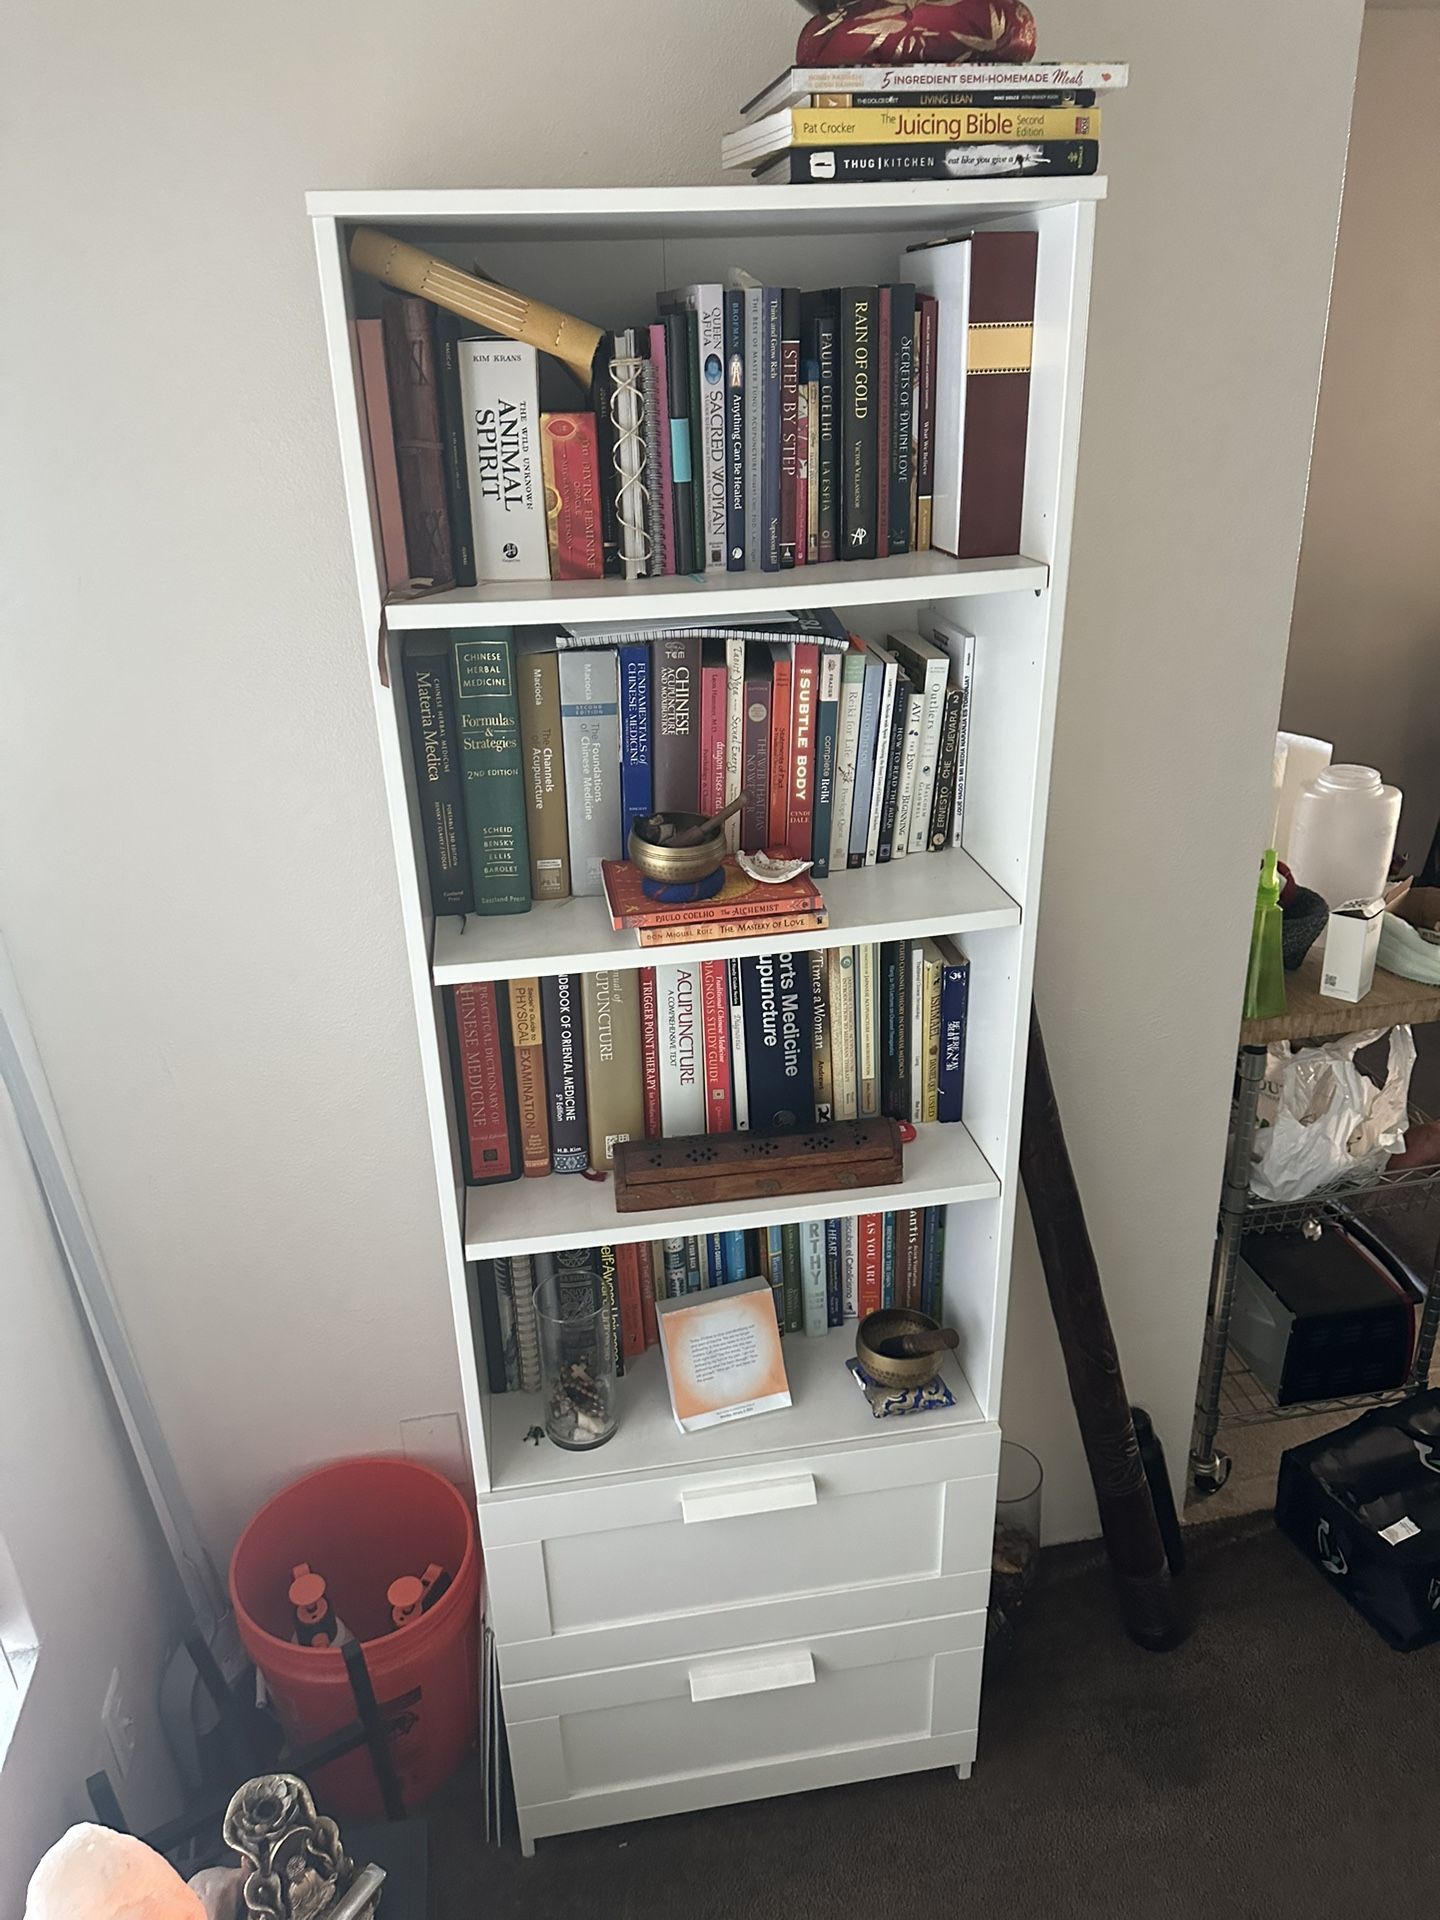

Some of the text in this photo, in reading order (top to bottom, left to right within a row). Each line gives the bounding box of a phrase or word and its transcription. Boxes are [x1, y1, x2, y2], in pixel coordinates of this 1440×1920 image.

[881, 71, 894, 89] 5
[893, 75, 957, 86] INGREDIENT
[960, 74, 1049, 85] SEMI-HOMEMADE
[1052, 69, 1084, 86] Meals
[920, 95, 973, 105] LIVING LEAN
[803, 122, 855, 134] Pat Crocker
[881, 113, 1013, 140] The Juicing Bible
[1016, 115, 1044, 126] Second
[1016, 127, 1044, 137] Edition
[844, 157, 935, 168] THUG KITCHEN
[977, 157, 991, 167] you
[712, 307, 722, 350] QUEEN
[770, 299, 779, 379] Think Rich
[472, 353, 522, 363] KIM KRANS
[782, 350, 798, 394] STEP
[855, 302, 868, 419] RAIN OF GOLD
[821, 332, 833, 441] PAULO COELHO
[783, 402, 798, 425] BY
[898, 336, 913, 484] SECRETS OF DIVINE LOVE
[474, 410, 501, 501] SPIRIT
[498, 399, 523, 512] ANIMAL
[519, 401, 533, 511] THE WILD UNKNOWN
[709, 391, 726, 536] SACRED WOMAN
[731, 394, 742, 510] Anything Can Be Healed
[782, 433, 797, 476] STEP
[822, 460, 831, 475] LA
[584, 510, 597, 570] FEMININE
[464, 653, 502, 663] CHINESE
[467, 666, 501, 675] HERBAL
[463, 678, 508, 688] MEDICINE
[533, 668, 544, 706] Maciocia
[583, 663, 593, 701] Maciocia
[660, 666, 669, 736] AND MOXIBUSTION
[667, 667, 676, 736] ACUPUNCTURE
[675, 667, 690, 736] CHINESE
[728, 646, 743, 743] Taoist Yoga Sexual
[416, 672, 442, 781] Materia Medica
[462, 713, 516, 728] Formulas
[627, 663, 639, 766] CHINESE MEDICINE
[637, 663, 649, 765] FUNDAMENTALS of
[843, 691, 859, 758] Reiki for Life
[911, 703, 921, 722] AVI
[926, 683, 941, 729] Outliers
[464, 736, 518, 753] Strategies
[485, 728, 495, 738] &
[795, 678, 811, 800] SUBTLE BODY
[440, 740, 451, 773] MEDICINE
[467, 769, 519, 780] 2ND EDITION
[532, 748, 544, 809] Acupuncture
[544, 748, 556, 793] Channels
[580, 736, 594, 821] Chinese Medicine
[591, 723, 603, 803] The Foundations
[712, 741, 726, 810] dragon rises red
[746, 754, 756, 770] NO
[756, 736, 767, 809] THE THAT
[820, 735, 833, 804] complete Reiki
[890, 727, 904, 806] HOW TO READ THE
[937, 709, 961, 828] ERNESTO CHE GUEVARA
[899, 753, 915, 836] END BEGINNING
[483, 826, 513, 835] SCHEID
[483, 840, 515, 848] BENSKY
[484, 866, 519, 874] BAROLET
[655, 910, 715, 923] PAULO COELHO
[719, 918, 806, 935] THE MASTERY OF LOVE
[720, 903, 780, 917] The ALCHEMIST
[666, 928, 714, 940] MIGUEL RUIZ
[716, 976, 725, 1009] Traditional
[812, 956, 826, 1050] Times a Woman
[516, 987, 530, 1045] PHYSICAL
[529, 1014, 537, 1033] Guide
[642, 980, 657, 1091] TRIGGER POINT THERAPY
[668, 996, 677, 1049] COMPREHENSIVE
[677, 969, 694, 1087] ACUPUNCTURE
[780, 993, 800, 1077] Medicine
[929, 995, 942, 1042] ISHMAEL
[480, 986, 501, 1125] PRACTICAL DICTIONARY OF
[560, 1015, 577, 1121] OF ORIENTAL MEDICINE
[669, 1051, 677, 1067] TEXT
[707, 1016, 720, 1083] STUDY GUIDE
[718, 1035, 726, 1063] Medicine
[465, 1052, 488, 1128] MEDICINE
[520, 1048, 536, 1129] EXAMINATION
[927, 1096, 936, 1119] USED
[556, 1102, 564, 1122] Edition
[827, 1229, 837, 1257] HEART
[866, 1221, 876, 1285] AS YOU ARE
[845, 1257, 855, 1299] Catolicismo
